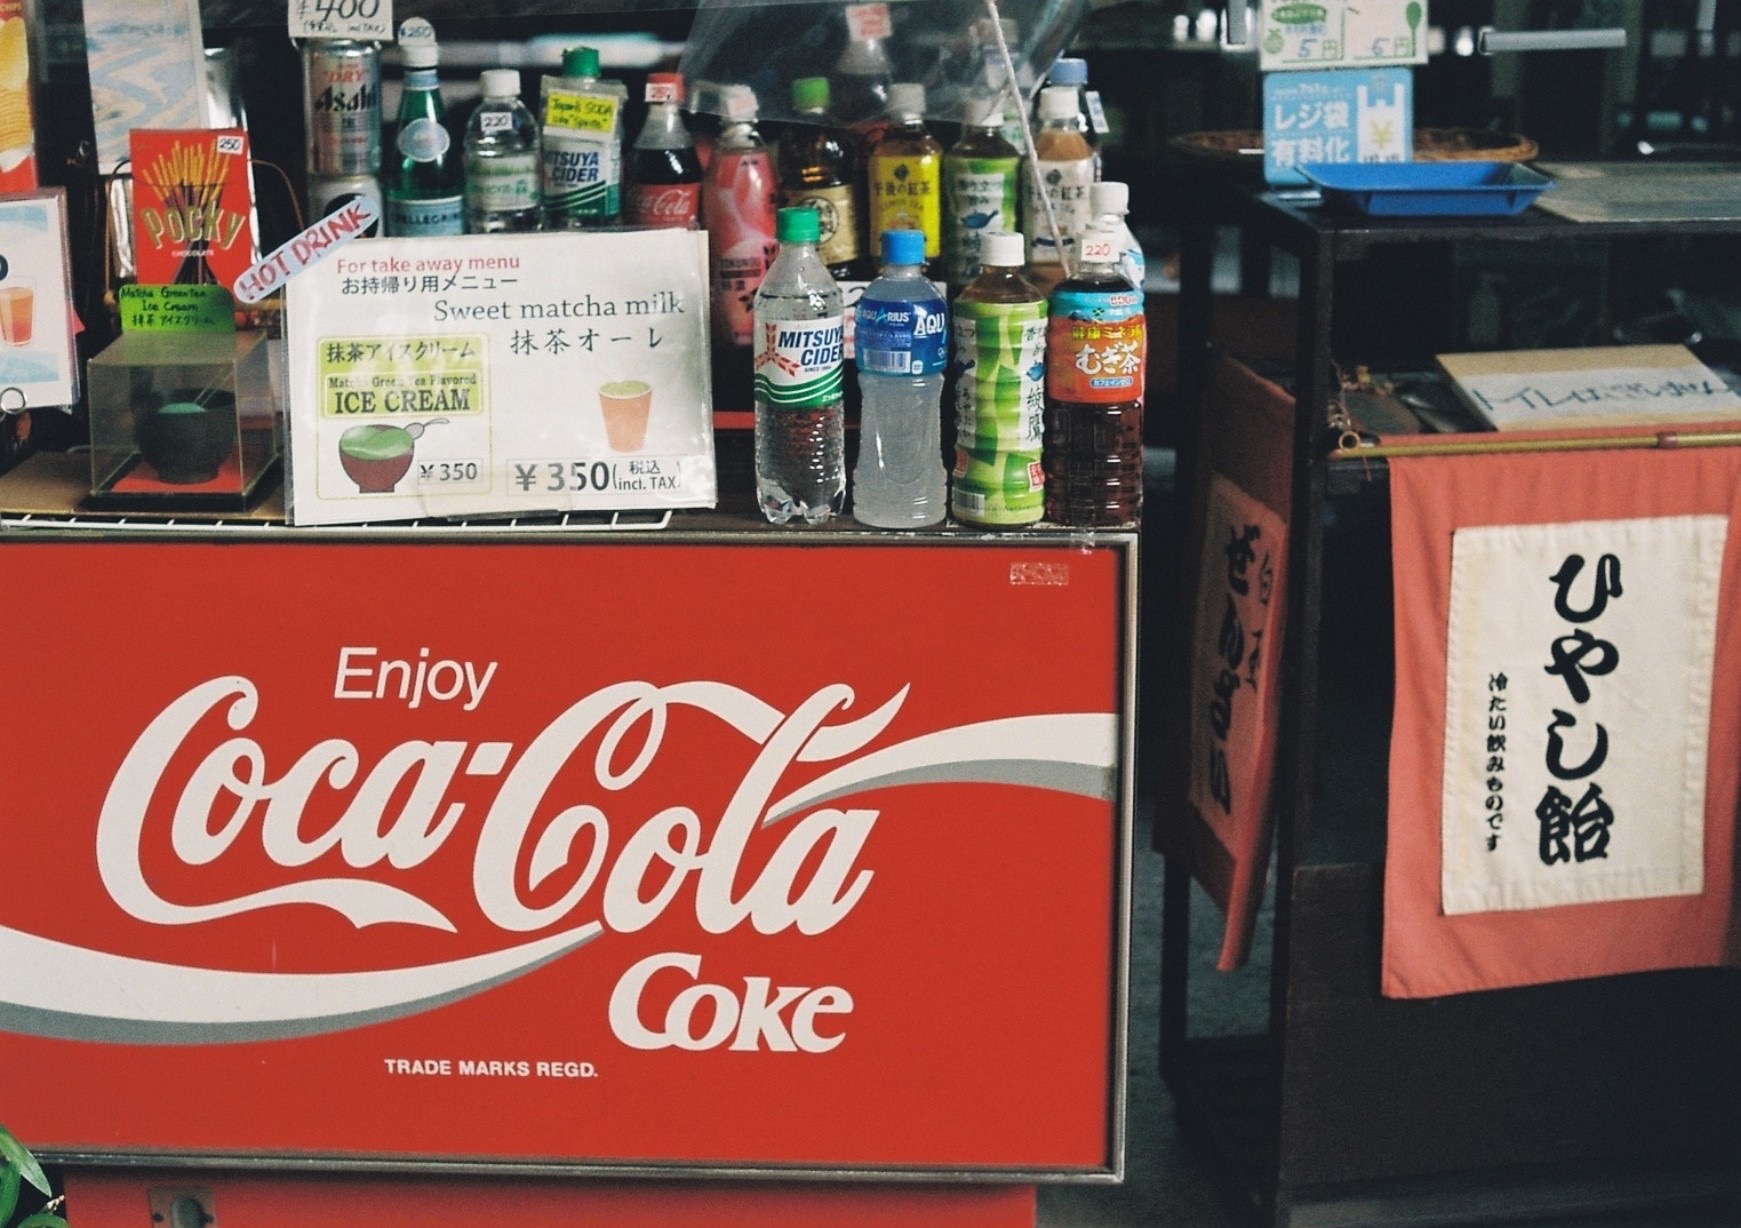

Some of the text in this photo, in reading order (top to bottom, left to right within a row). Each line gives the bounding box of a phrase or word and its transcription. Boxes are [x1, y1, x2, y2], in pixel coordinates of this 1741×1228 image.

[484, 116, 509, 128] 220
[1275, 101, 1349, 130] レジ袋
[218, 138, 241, 151] 250
[552, 167, 599, 184] CIDER
[141, 201, 246, 250] POCKY
[239, 203, 371, 300] HOT DRINK
[1085, 243, 1111, 256] 220
[337, 256, 520, 274] For take away menu
[341, 275, 518, 295] お持帰り用メニュー
[434, 291, 685, 322] Sweet matcha milk
[327, 341, 475, 363] 抹茶アイスクリーム
[510, 327, 663, 356] 抹茶オーレ
[1076, 339, 1141, 374] むぎ茶
[430, 373, 477, 386] Favored
[335, 388, 470, 415] ICE CREAM
[420, 462, 478, 482] ¥350
[515, 461, 609, 492] ¥350
[630, 459, 661, 475] 税込
[619, 477, 646, 491] incl.
[333, 647, 498, 711] Enjoy
[1536, 553, 1623, 866] ひやし飴
[1485, 671, 1509, 851] 冷たい飲みものです
[96, 675, 911, 936] Coca-Cola
[608, 952, 854, 1054] Coke
[384, 1059, 599, 1078] TRADE MARKS REGD.
